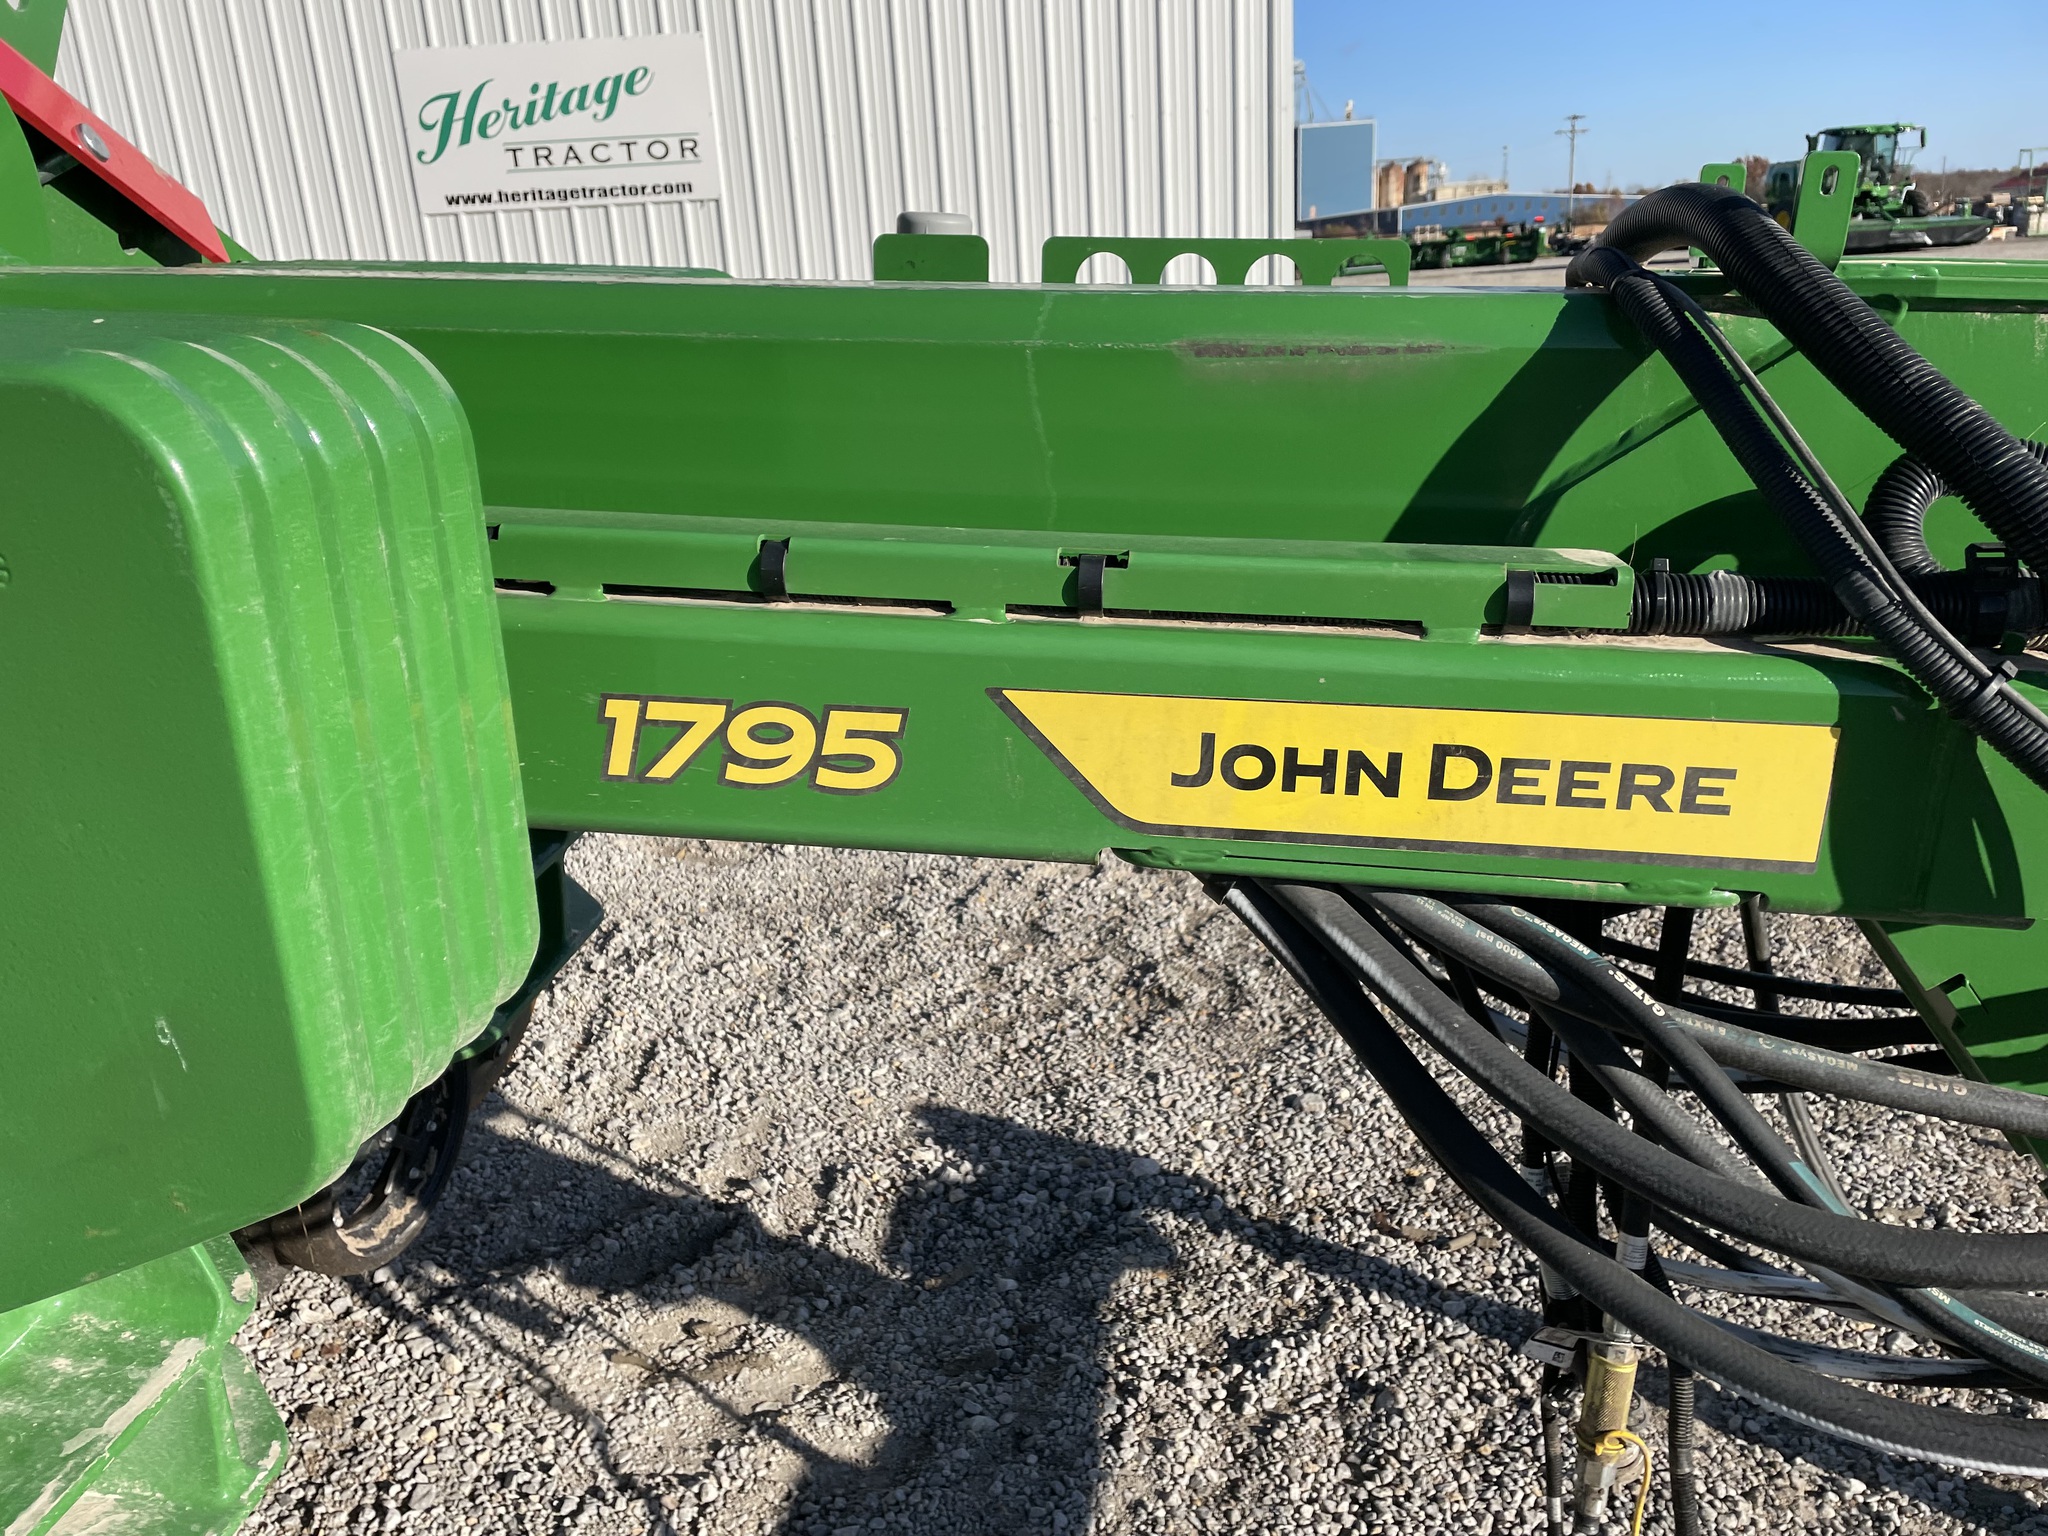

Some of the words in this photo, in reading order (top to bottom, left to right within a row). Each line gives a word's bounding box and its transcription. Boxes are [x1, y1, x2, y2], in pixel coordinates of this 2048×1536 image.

[416, 65, 654, 165] Heritage
[505, 138, 700, 168] TRACTOR
[445, 181, 693, 206] www.heritagetractor.com
[602, 697, 905, 791] 1795
[1170, 731, 1403, 799] JOHN
[1426, 742, 1739, 817] DEERE
[1609, 969, 1666, 1017] GATES
